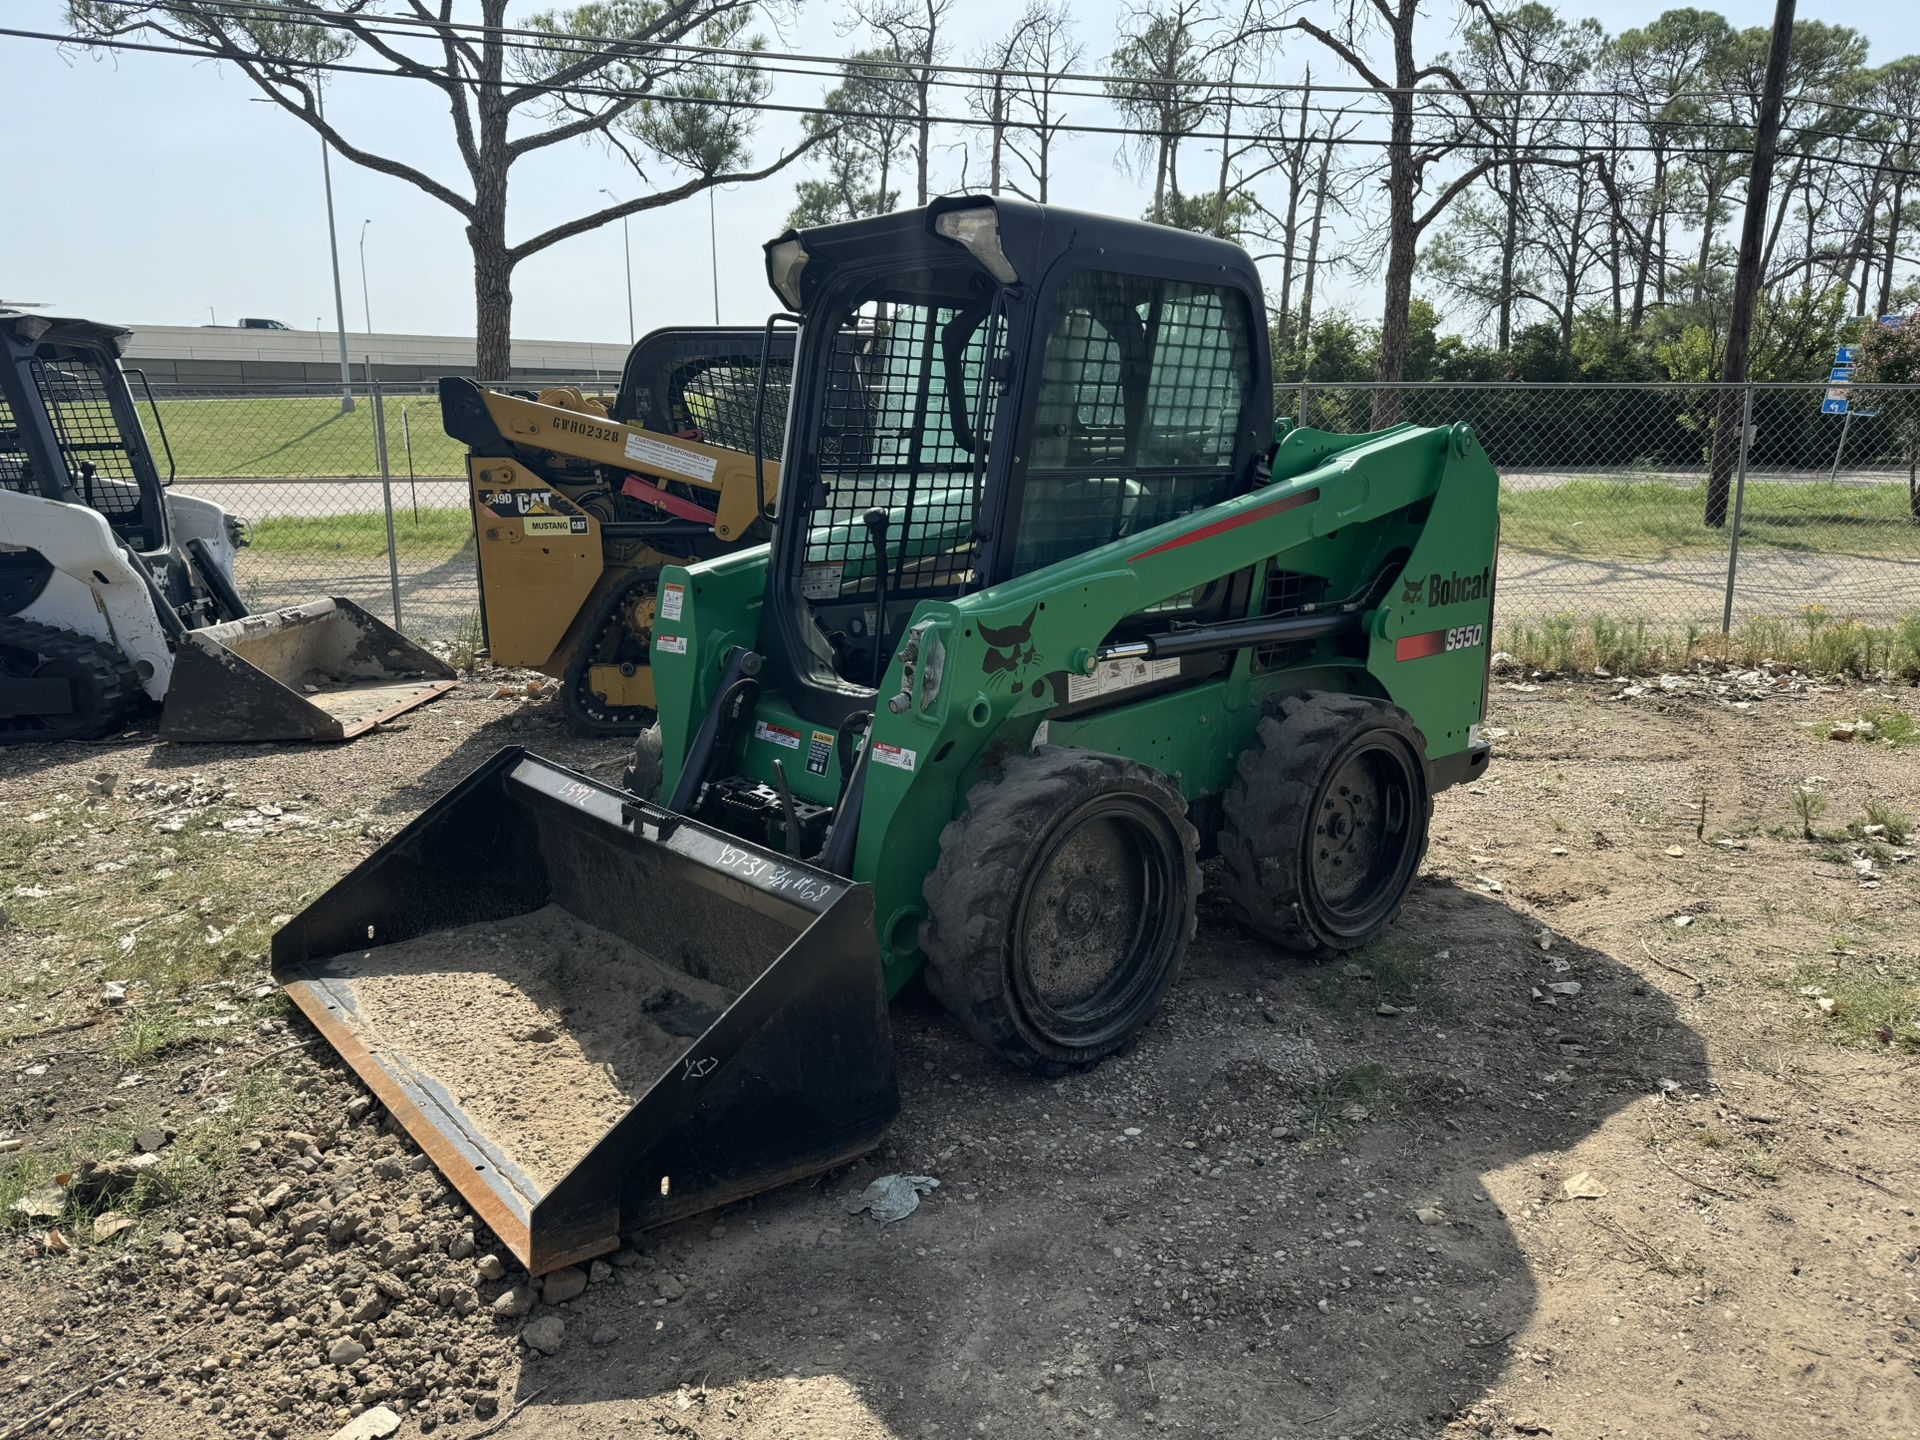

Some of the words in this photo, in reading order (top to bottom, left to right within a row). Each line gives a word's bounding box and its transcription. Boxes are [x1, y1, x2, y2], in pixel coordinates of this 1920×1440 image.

[552, 416, 620, 443] GWR02328
[515, 491, 552, 514] CAT
[532, 521, 568, 530] MUSTANG
[571, 520, 586, 530] CAT
[1428, 566, 1490, 608] Bobcat
[1446, 623, 1483, 651] S550
